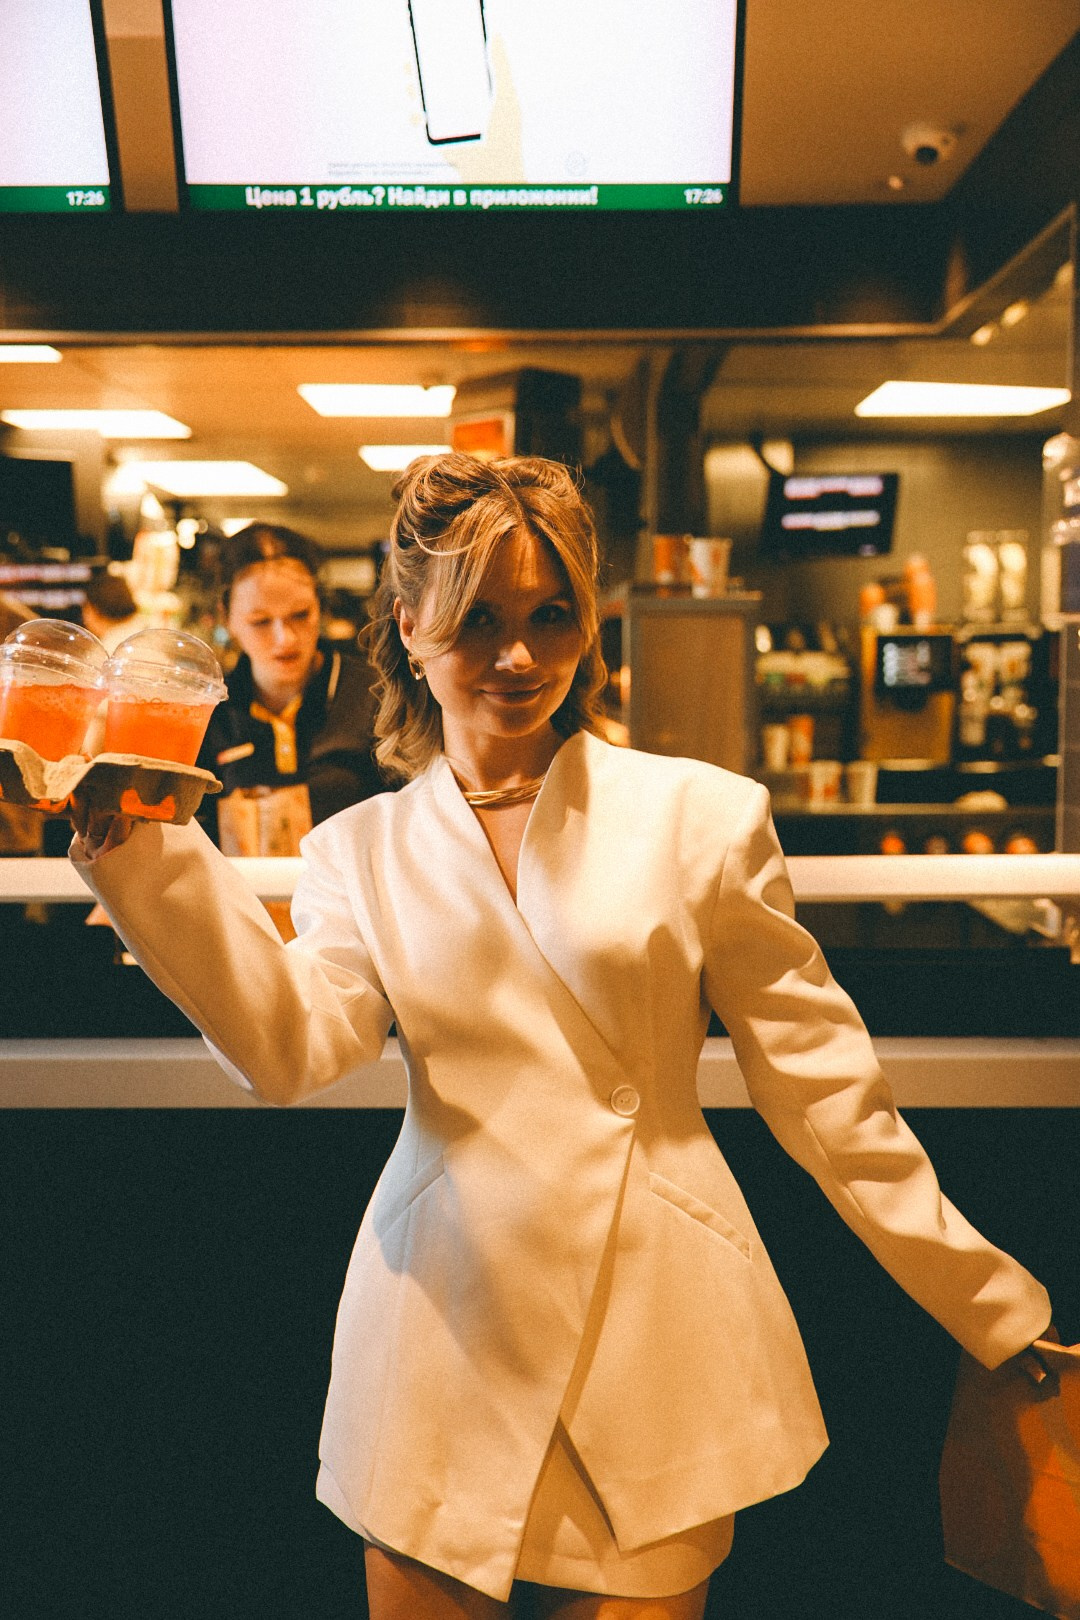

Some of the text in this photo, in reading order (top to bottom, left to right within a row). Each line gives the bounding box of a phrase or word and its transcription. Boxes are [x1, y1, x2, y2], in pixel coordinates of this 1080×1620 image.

[245, 186, 297, 209] Цена
[300, 186, 314, 206] 1
[316, 186, 386, 210] рубль?
[388, 186, 450, 208] Найди
[453, 190, 467, 206] в
